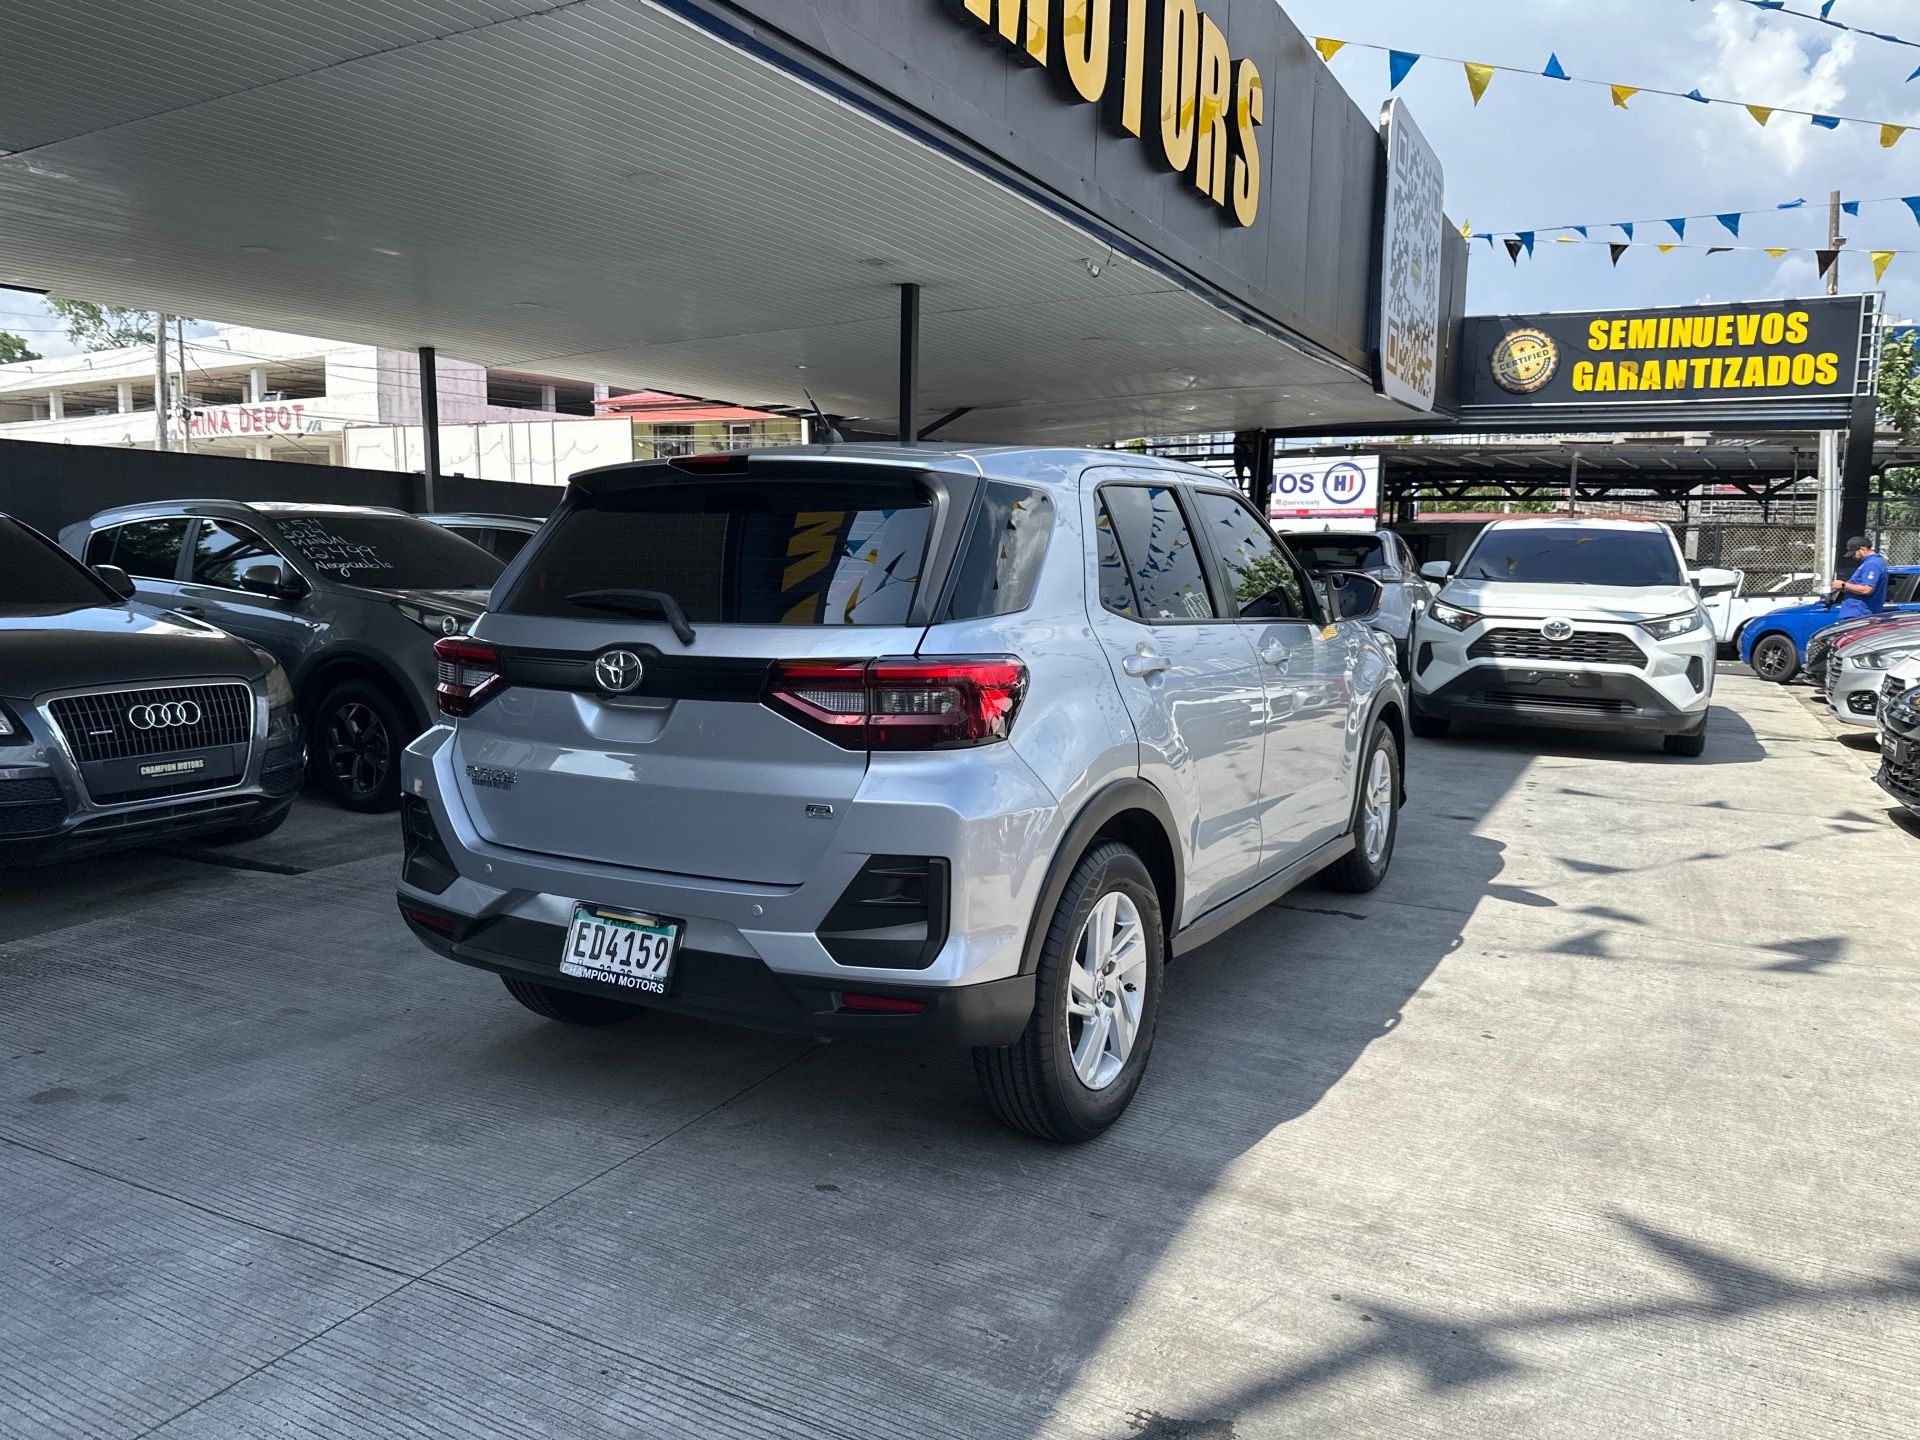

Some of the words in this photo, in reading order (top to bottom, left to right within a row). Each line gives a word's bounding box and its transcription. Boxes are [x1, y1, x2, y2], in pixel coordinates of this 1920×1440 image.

[1587, 311, 1809, 351] SEMINUEVOS
[1500, 349, 1549, 371] CERTIFIED
[1572, 352, 1839, 391] GARANTIZADOS
[239, 404, 304, 433] DEPOT
[1333, 474, 1355, 493] HJ
[290, 536, 354, 547] MANUAL
[140, 763, 177, 775] CHAMPION
[177, 759, 205, 770] MOTORS
[573, 921, 669, 972] ED4159
[562, 964, 617, 984] CHAMPION
[617, 974, 665, 994] MOTORS
